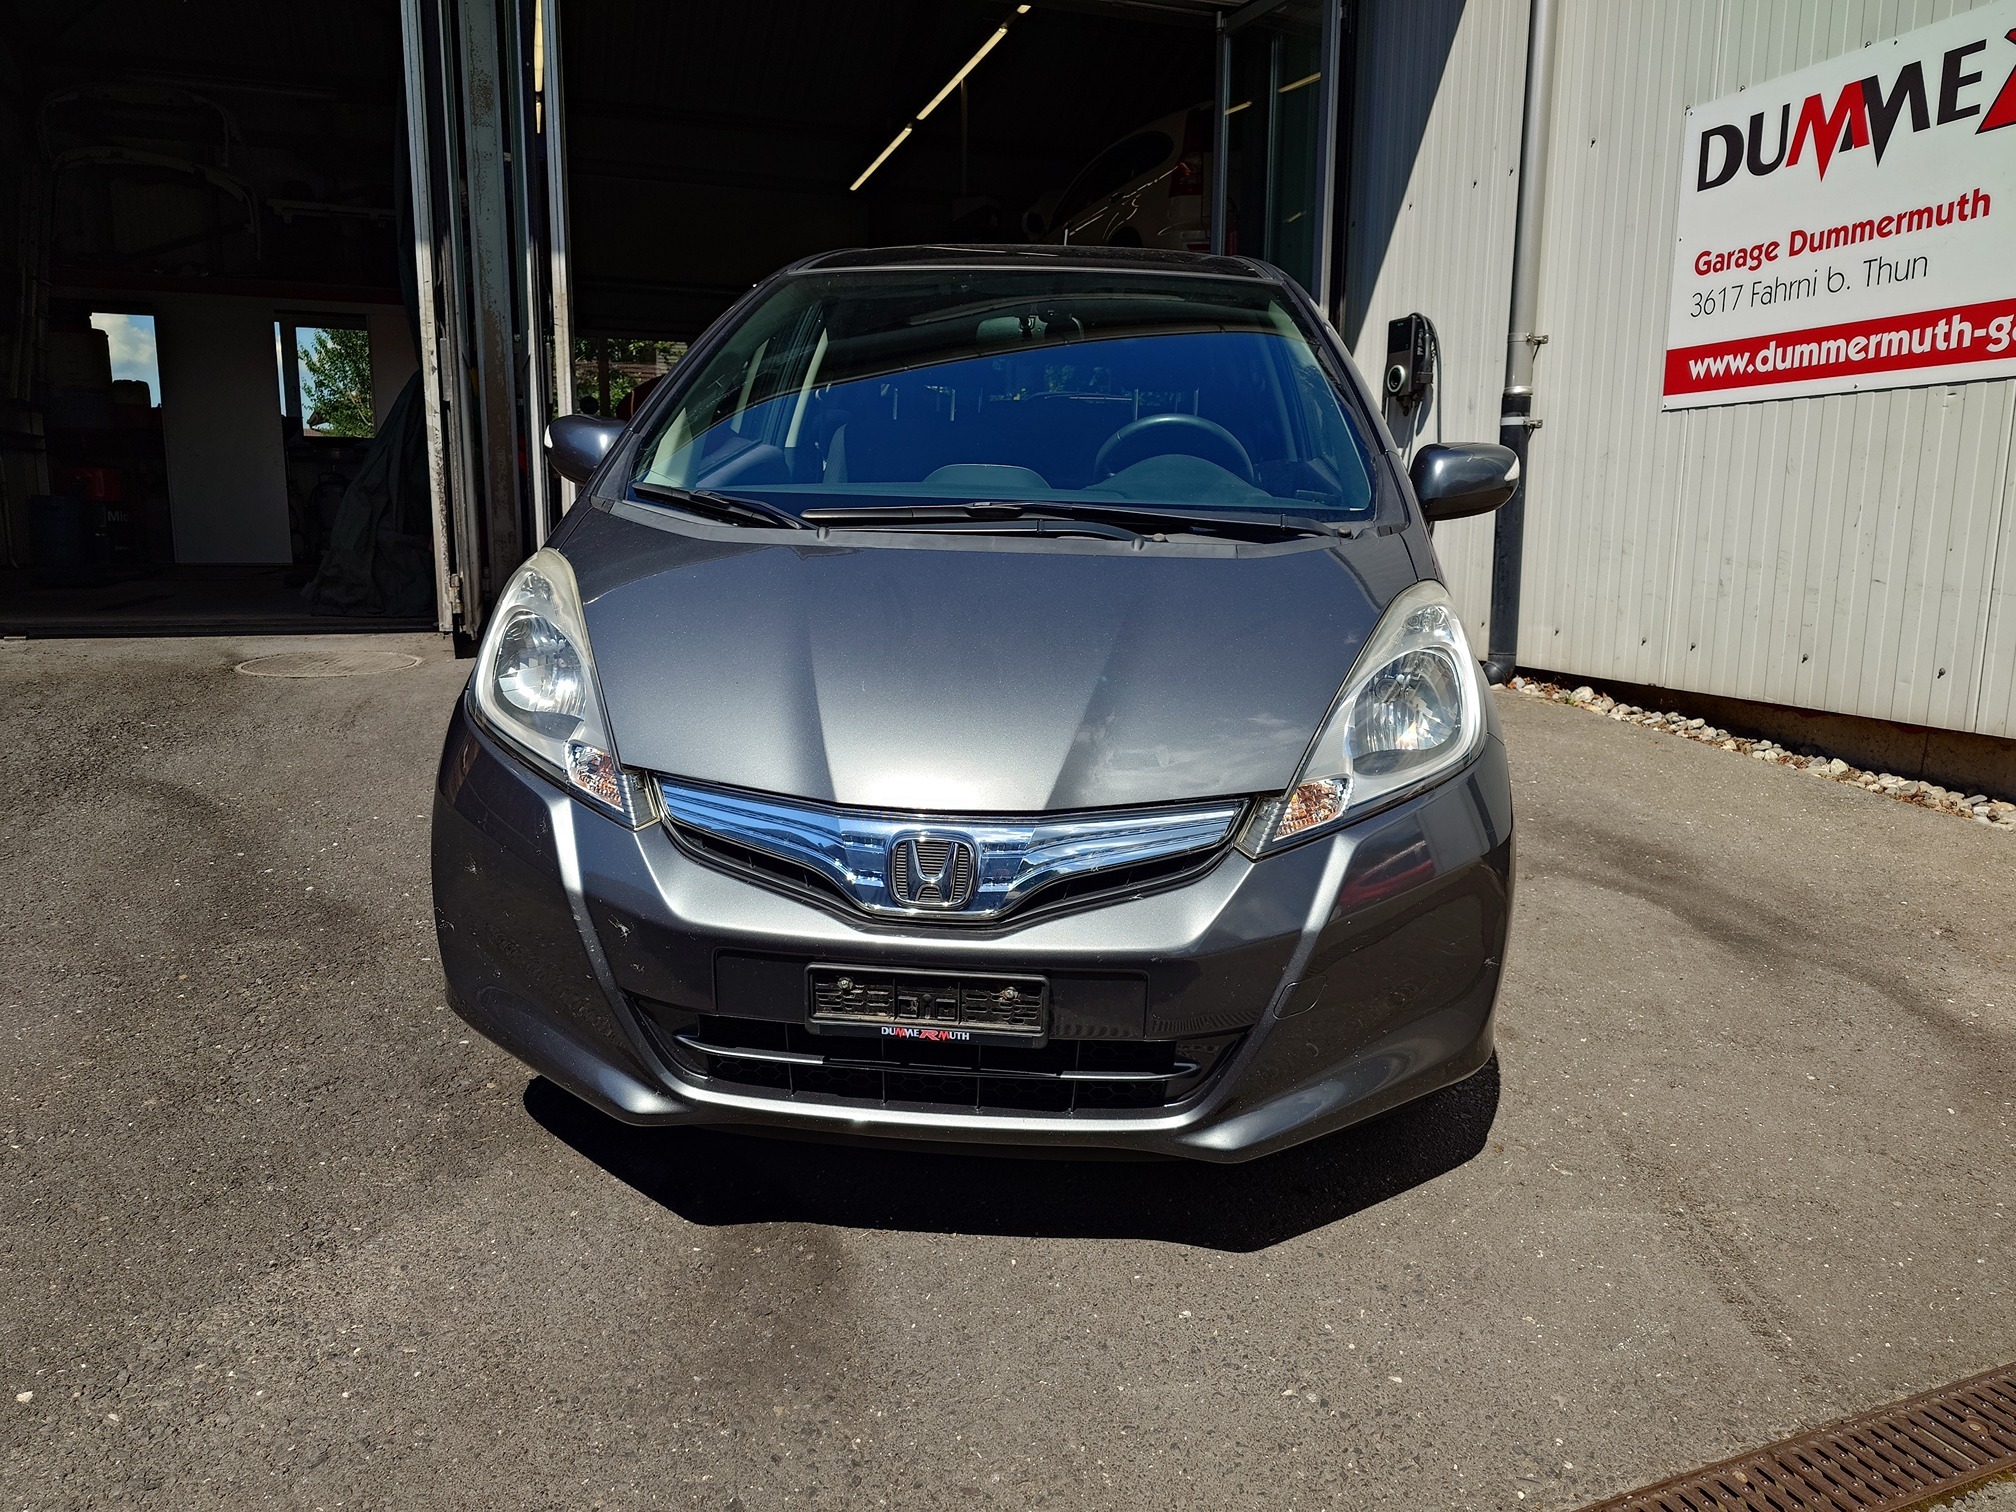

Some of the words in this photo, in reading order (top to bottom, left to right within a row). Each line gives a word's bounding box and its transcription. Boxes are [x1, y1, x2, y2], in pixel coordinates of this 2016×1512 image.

[1696, 27, 2016, 192] DUMME
[1694, 239, 1779, 276] Garage
[1789, 188, 1991, 257] Dummermuth
[1690, 284, 1744, 318] 3617
[1750, 269, 1818, 307] Fahrni
[1827, 266, 1851, 294] b.
[1863, 254, 1928, 287] Thun
[1688, 314, 2016, 381] www.dummermuth-g
